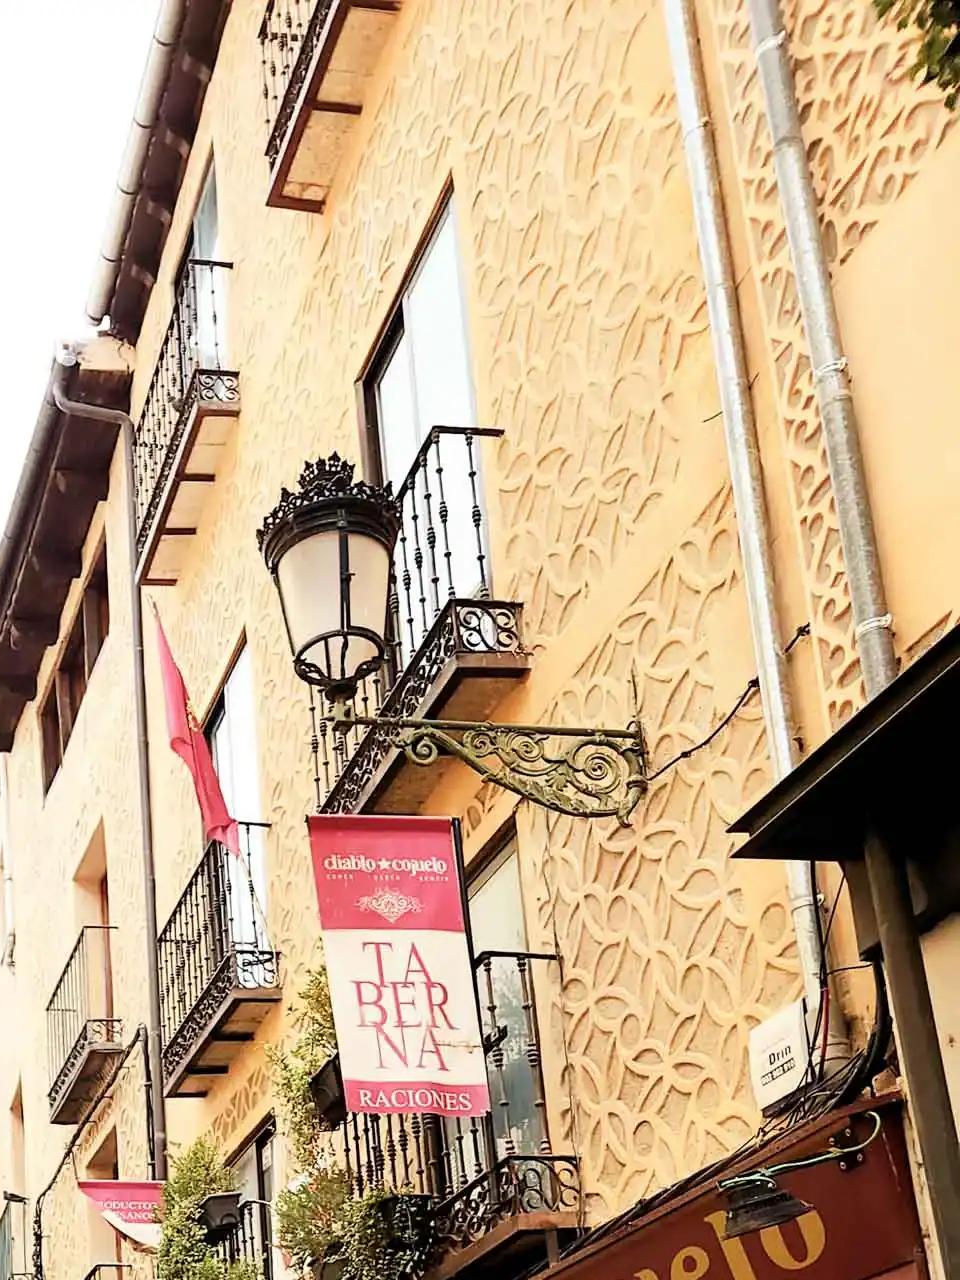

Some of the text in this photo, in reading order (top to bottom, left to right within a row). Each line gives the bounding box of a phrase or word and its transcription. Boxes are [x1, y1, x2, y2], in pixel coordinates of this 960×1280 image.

[323, 854, 447, 877] diablo cojuelo
[362, 941, 431, 988] TA
[351, 980, 459, 1031] BER
[367, 1022, 449, 1072] NA
[359, 1088, 472, 1111] RACIONES
